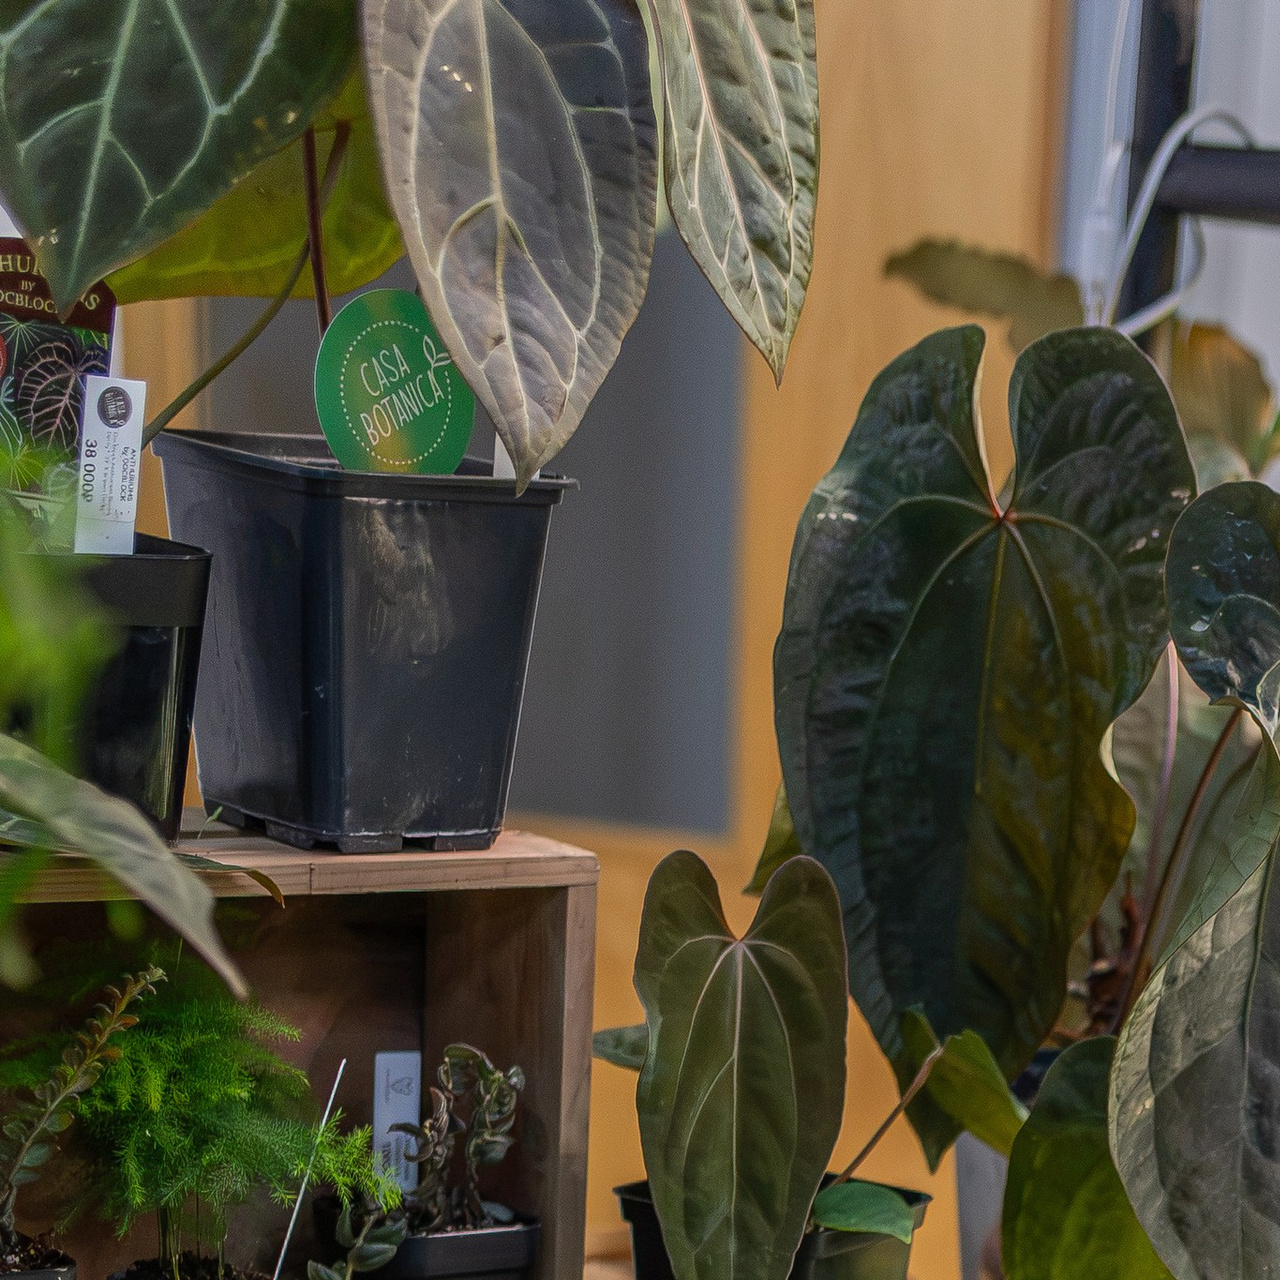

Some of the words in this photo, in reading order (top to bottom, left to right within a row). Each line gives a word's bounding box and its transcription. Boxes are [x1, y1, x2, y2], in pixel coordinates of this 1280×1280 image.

[361, 344, 410, 396] CASA
[361, 370, 444, 445] BOTANICA
[85, 438, 98, 458] 38
